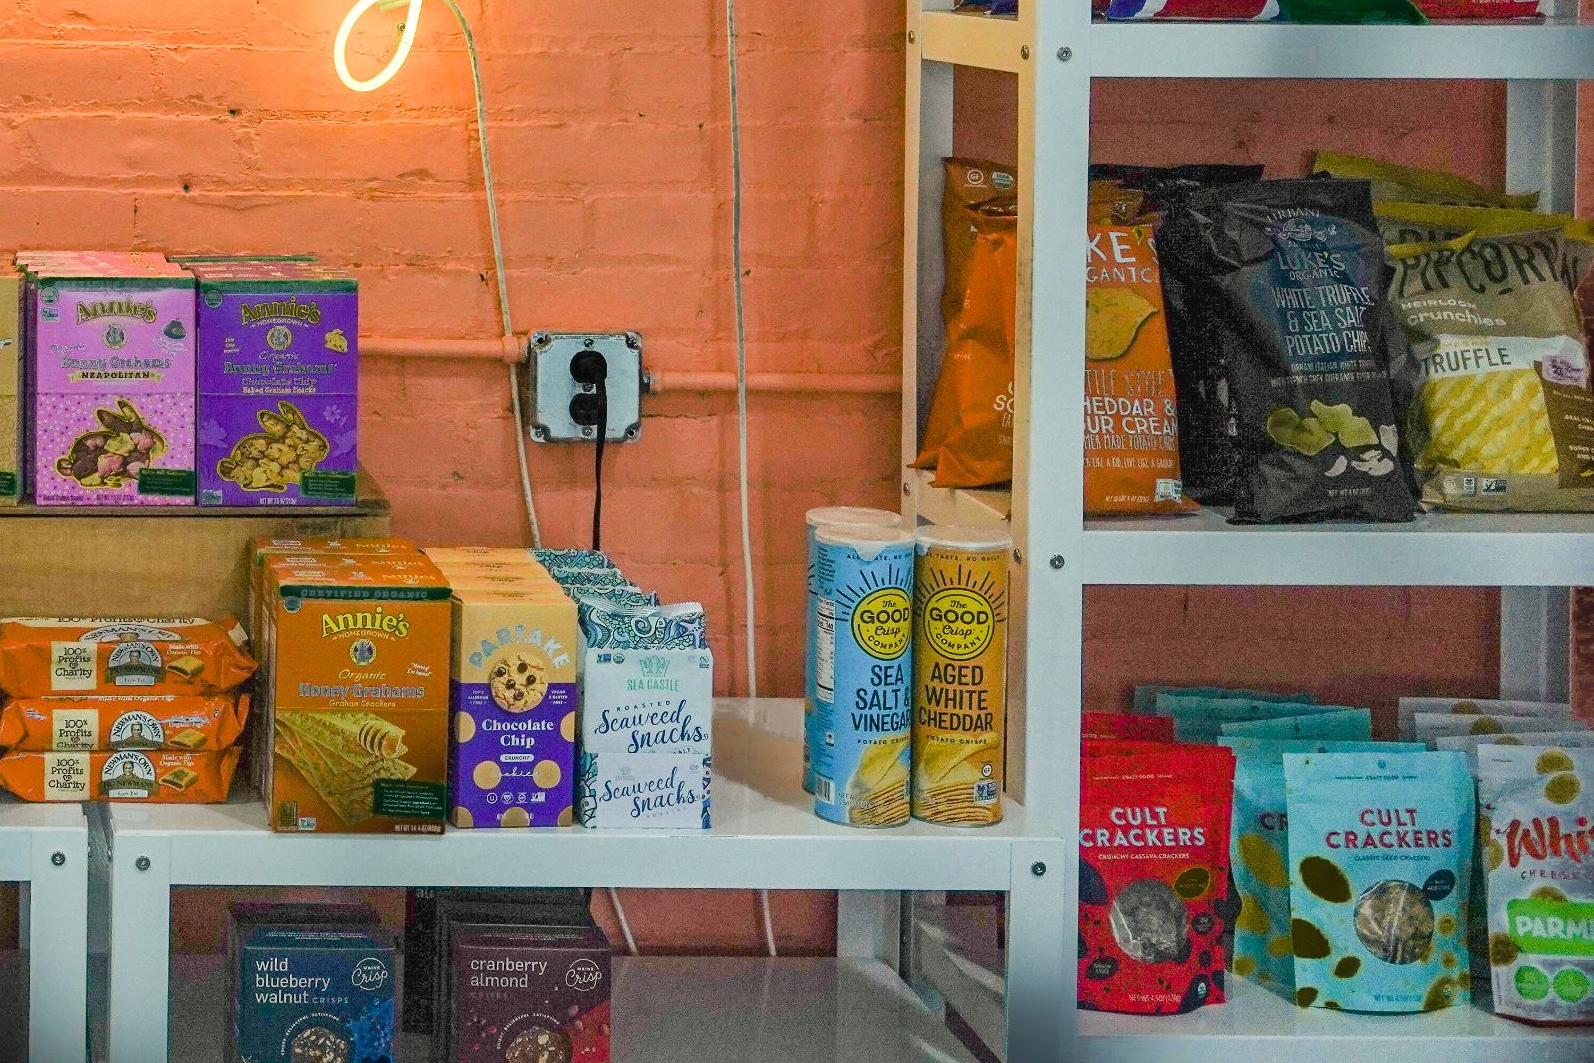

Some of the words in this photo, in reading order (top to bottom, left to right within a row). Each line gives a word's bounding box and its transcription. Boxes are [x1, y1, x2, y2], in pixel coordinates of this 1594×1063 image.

[1276, 251, 1346, 271] LUKE'S
[1289, 268, 1341, 281] ORGANIC
[1271, 286, 1316, 309] WHITE
[76, 299, 158, 326] Annie's
[240, 295, 322, 326] Annie's
[1408, 308, 1507, 328] crunchies
[1286, 310, 1300, 333] &
[1302, 309, 1333, 332] SEA
[1286, 333, 1341, 357] POTATO
[1421, 347, 1512, 376] TRUFFLE
[81, 370, 151, 380] NEAPOLITAN
[882, 600, 897, 609] The
[950, 600, 968, 609] The
[320, 605, 411, 639] Annie's
[859, 607, 910, 625] GOOD
[929, 606, 989, 626] GOOD
[866, 632, 907, 651] COMPANY
[874, 625, 901, 640] Crisp
[935, 632, 983, 651] COMPANY
[942, 624, 974, 640] Crisp
[63, 647, 87, 656] 100%
[468, 624, 570, 670] PARTAKE
[57, 655, 91, 667] Profits
[55, 667, 94, 679] Charity
[338, 669, 387, 682] Organic
[870, 663, 905, 687] SEA
[930, 661, 984, 686] AGED
[298, 682, 350, 700] Honey
[352, 683, 426, 699] Grahams
[627, 679, 646, 691] SEA
[647, 679, 680, 692] CASTLE
[616, 700, 671, 712] ROASTED
[855, 687, 902, 711] SALT
[925, 685, 989, 712] WHITE
[112, 712, 148, 737] NEWMAN'S
[481, 718, 555, 732] Chocolate
[594, 698, 687, 735] Seaweed
[918, 706, 994, 733] CHEDDAR
[58, 728, 93, 738] Profits
[499, 732, 536, 750] Chip
[856, 738, 888, 746] POTATO
[959, 738, 988, 746] CRISPS
[50, 767, 85, 777] Profits
[103, 752, 140, 776] NEWMAN'S
[47, 779, 87, 791] Charity
[598, 766, 679, 803] Seaweed
[1109, 807, 1169, 826] CULT
[1359, 808, 1418, 827] CULT
[1079, 827, 1207, 848] CRACKERS
[1325, 829, 1453, 850] CRACKERS
[255, 957, 289, 972] wild
[470, 957, 548, 976] cranberry
[255, 972, 331, 991] blueberry
[350, 966, 389, 988] Crisp
[469, 974, 530, 989] almond
[564, 969, 603, 989] Crisp
[254, 990, 310, 1005] walnut
[312, 996, 349, 1005] CRISPS
